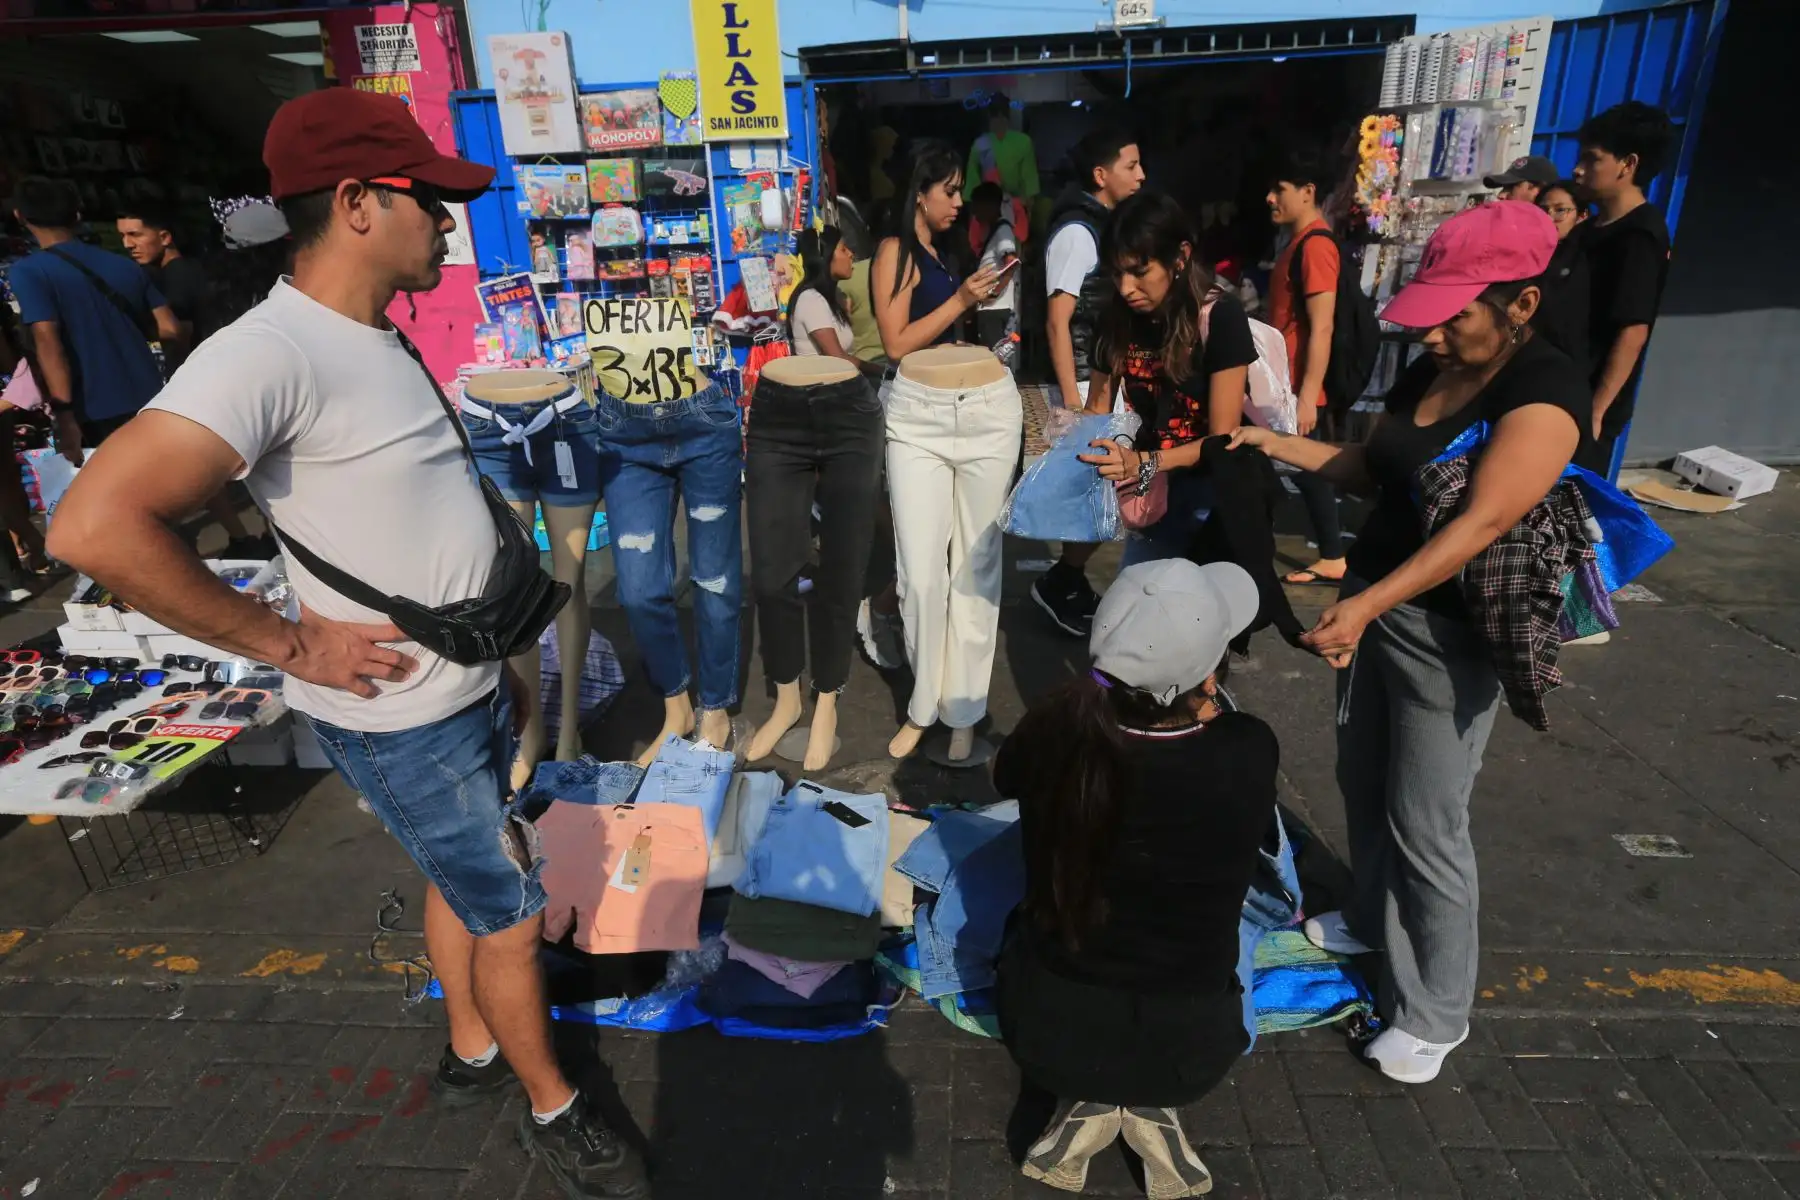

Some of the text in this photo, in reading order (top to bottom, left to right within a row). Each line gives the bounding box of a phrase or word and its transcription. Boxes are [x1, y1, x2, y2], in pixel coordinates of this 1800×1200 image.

[1121, 3, 1147, 17] 645
[361, 25, 408, 37] NECESITO
[360, 38, 415, 51] SEÑORITAS
[355, 76, 409, 94] OFERTA
[710, 116, 779, 130] SAN JACINTO
[591, 129, 657, 146] MONOPOLY
[486, 286, 533, 306] TINTES
[586, 299, 689, 334] OFERTA
[156, 725, 232, 738] OFERTA
[133, 741, 197, 763] 10
